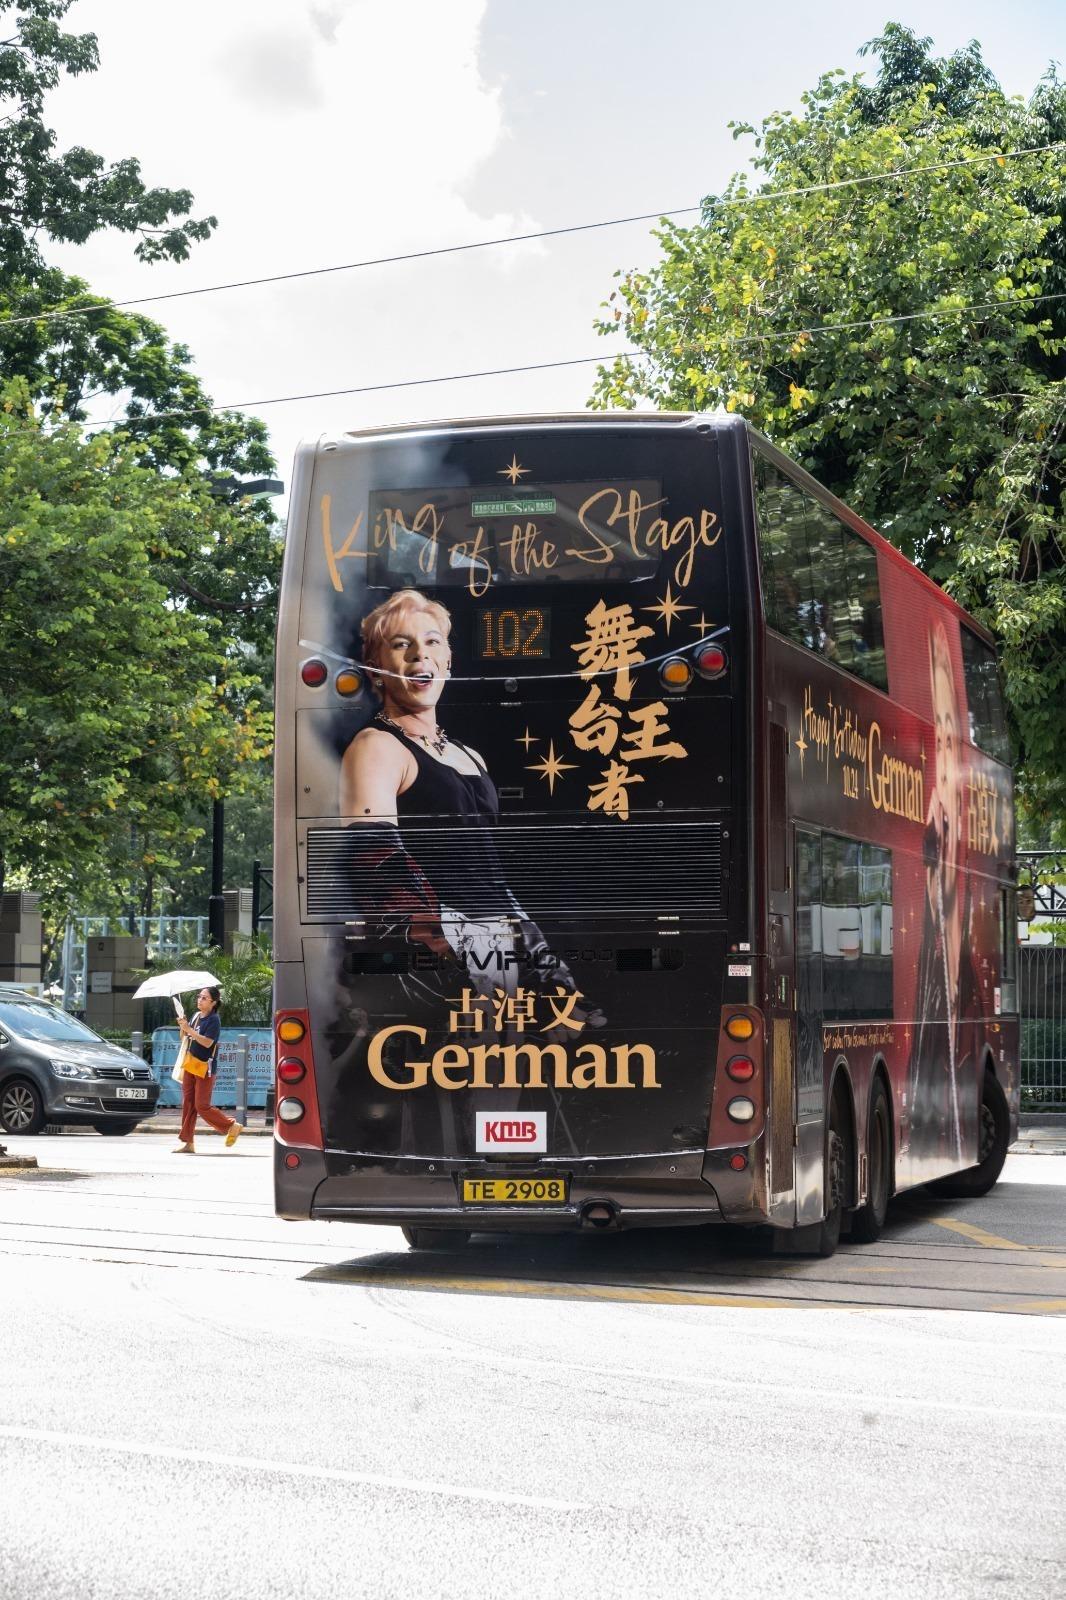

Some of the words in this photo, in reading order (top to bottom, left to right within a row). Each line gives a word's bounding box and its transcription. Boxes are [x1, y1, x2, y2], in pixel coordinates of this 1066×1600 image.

[320, 494, 445, 592] King
[447, 526, 497, 597] of
[499, 521, 559, 575] the
[565, 488, 722, 587] Stage
[481, 609, 544, 657] 102
[869, 721, 925, 825] German
[444, 986, 586, 1033] 古淖文
[367, 1024, 662, 1091] German
[119, 1088, 129, 1098] EC
[485, 1121, 538, 1143] KMB
[468, 1181, 496, 1199] TE
[505, 1181, 560, 1199] 2908
